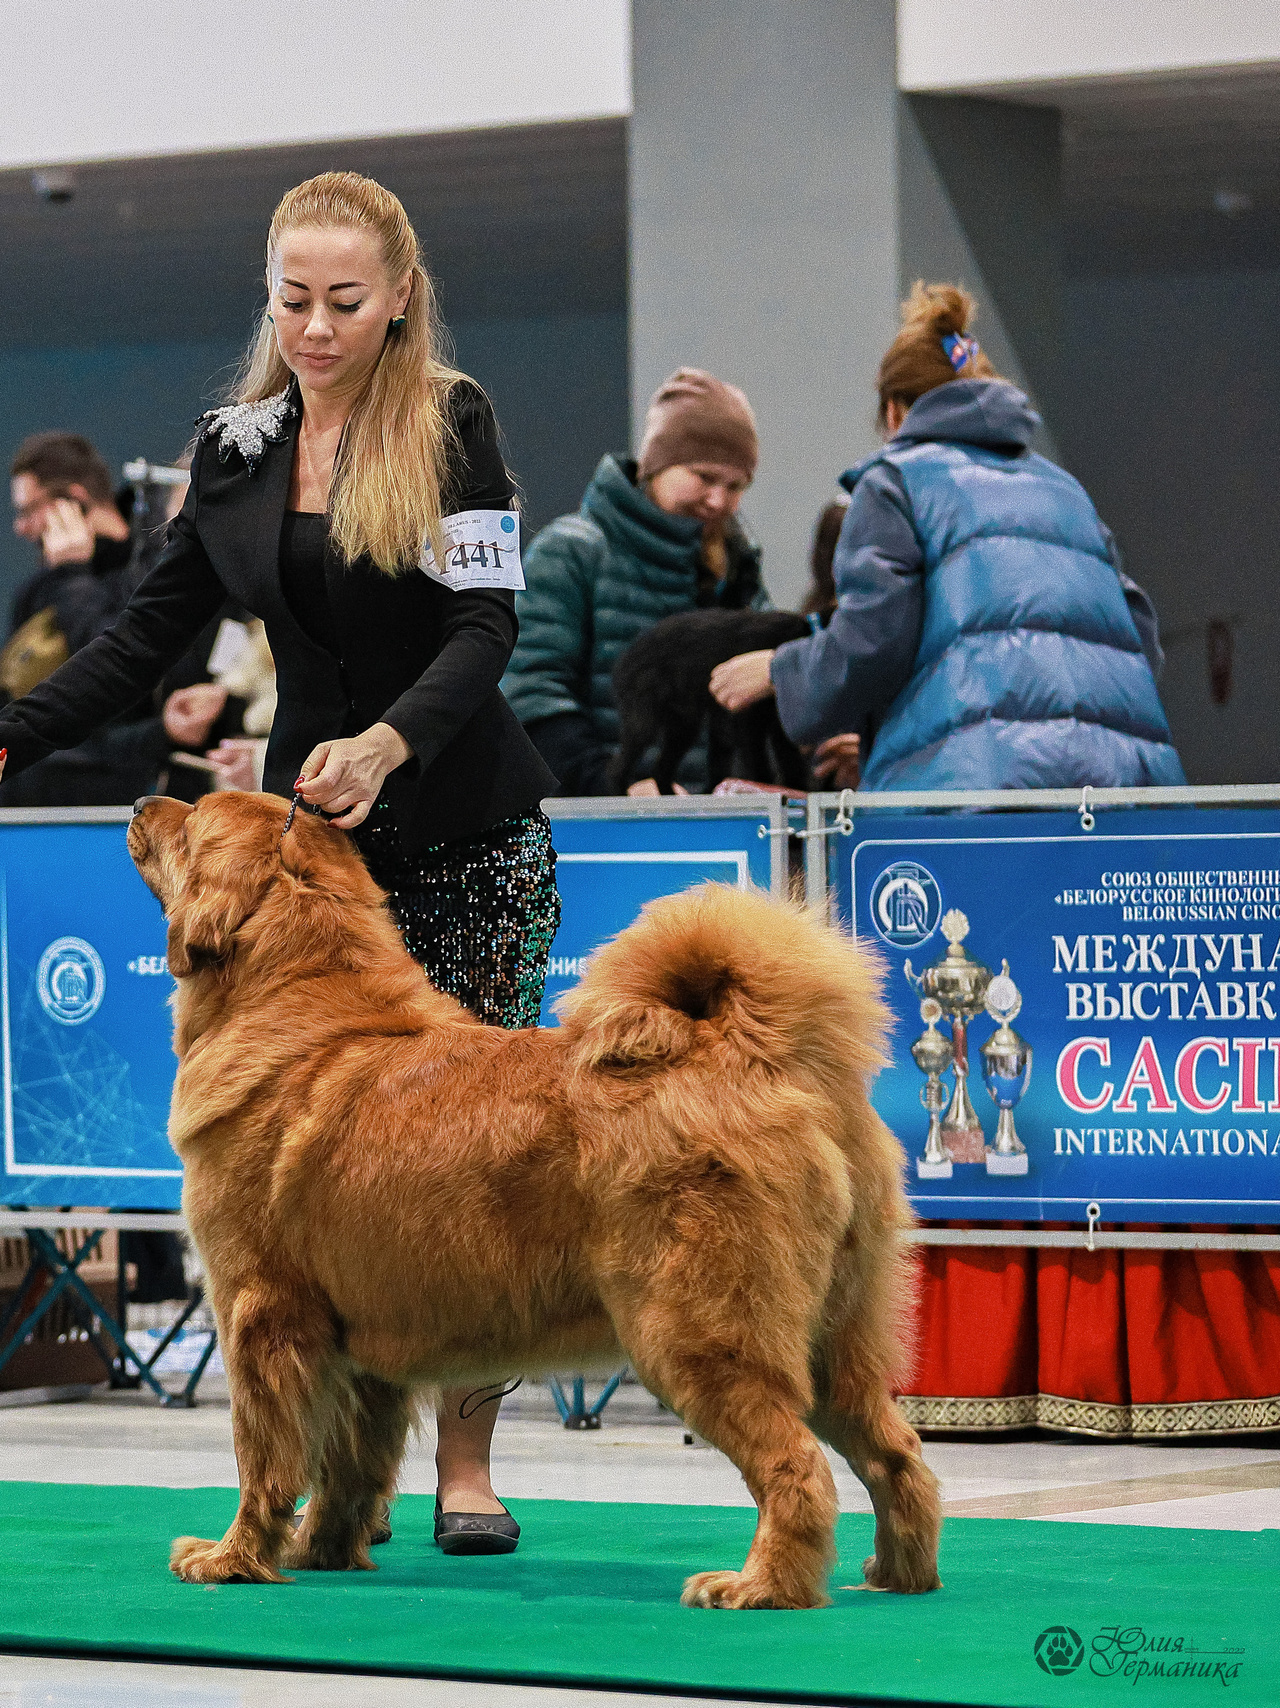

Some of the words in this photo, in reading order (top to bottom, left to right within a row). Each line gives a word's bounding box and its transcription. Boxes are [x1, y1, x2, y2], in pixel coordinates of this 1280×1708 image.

[1101, 871, 1151, 887] СОЮЗ
[1054, 888, 1186, 906] «БЕЛОРУССКОЕ
[1122, 905, 1237, 922] BELORUSSIAN
